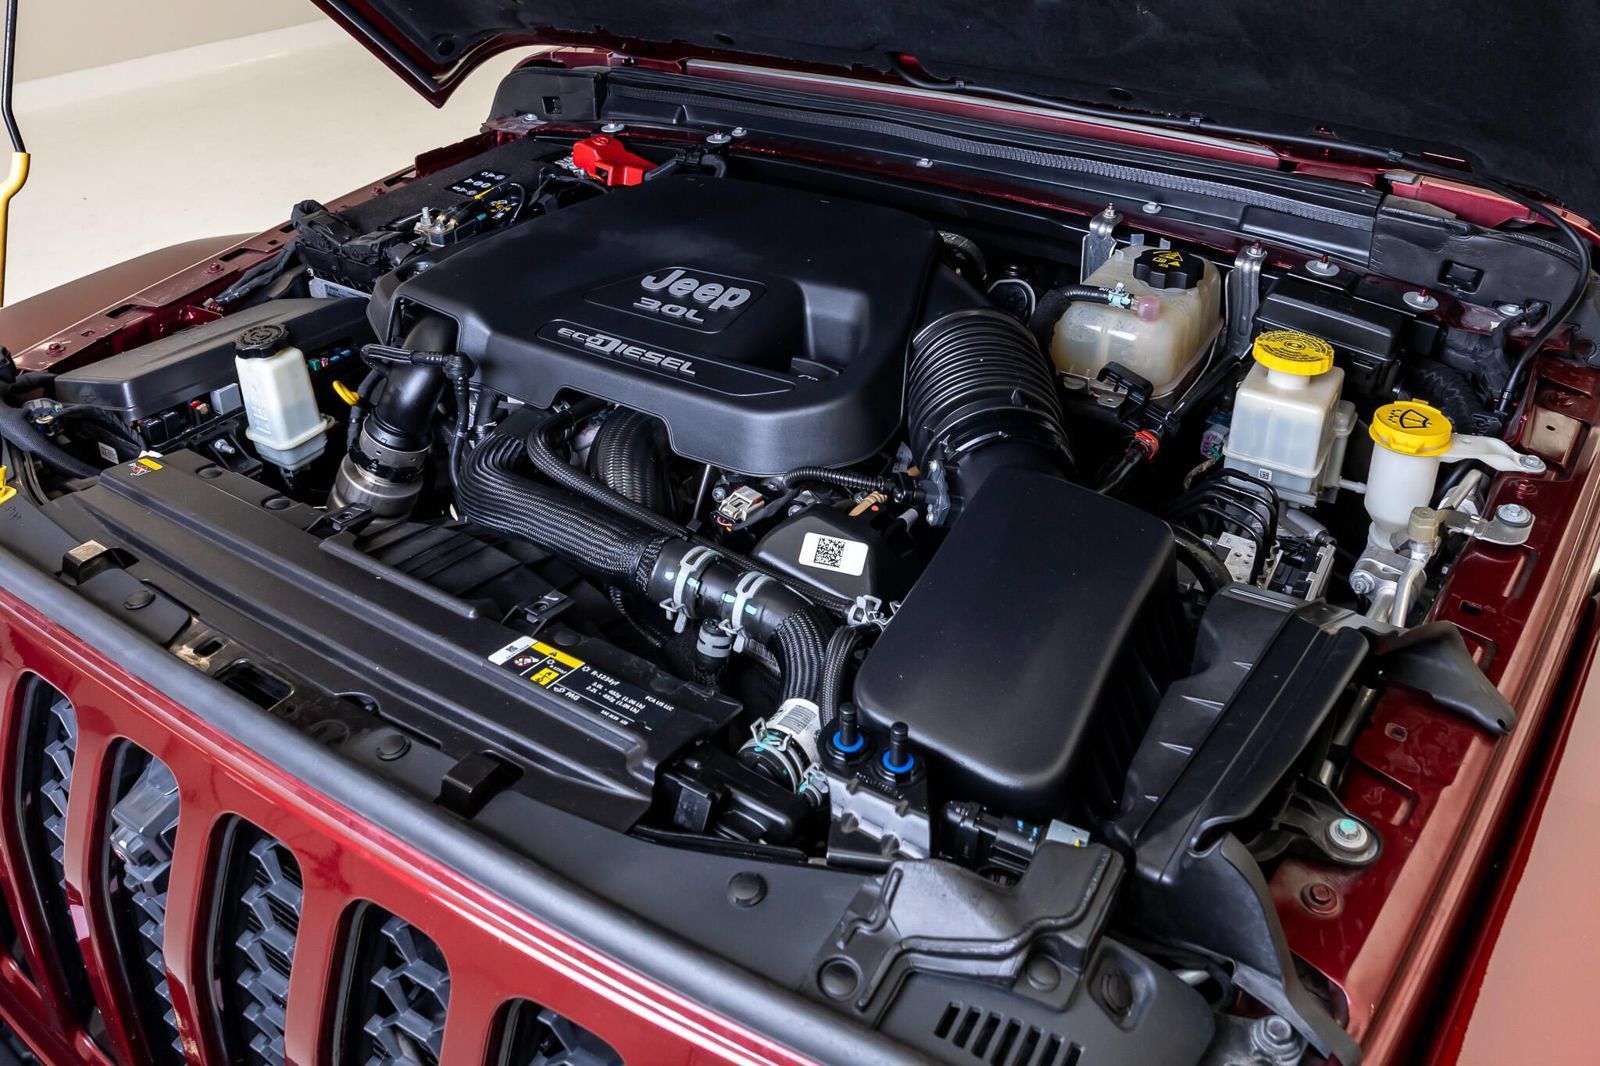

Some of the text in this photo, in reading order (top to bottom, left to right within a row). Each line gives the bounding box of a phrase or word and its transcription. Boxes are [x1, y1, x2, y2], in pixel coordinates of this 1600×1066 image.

[640, 269, 751, 312] Jeep
[633, 296, 705, 324] 3.0L
[590, 669, 620, 686] R-1234yf
[565, 691, 581, 701] PAG
[644, 695, 657, 704] FCA
[663, 704, 675, 712] LLC
